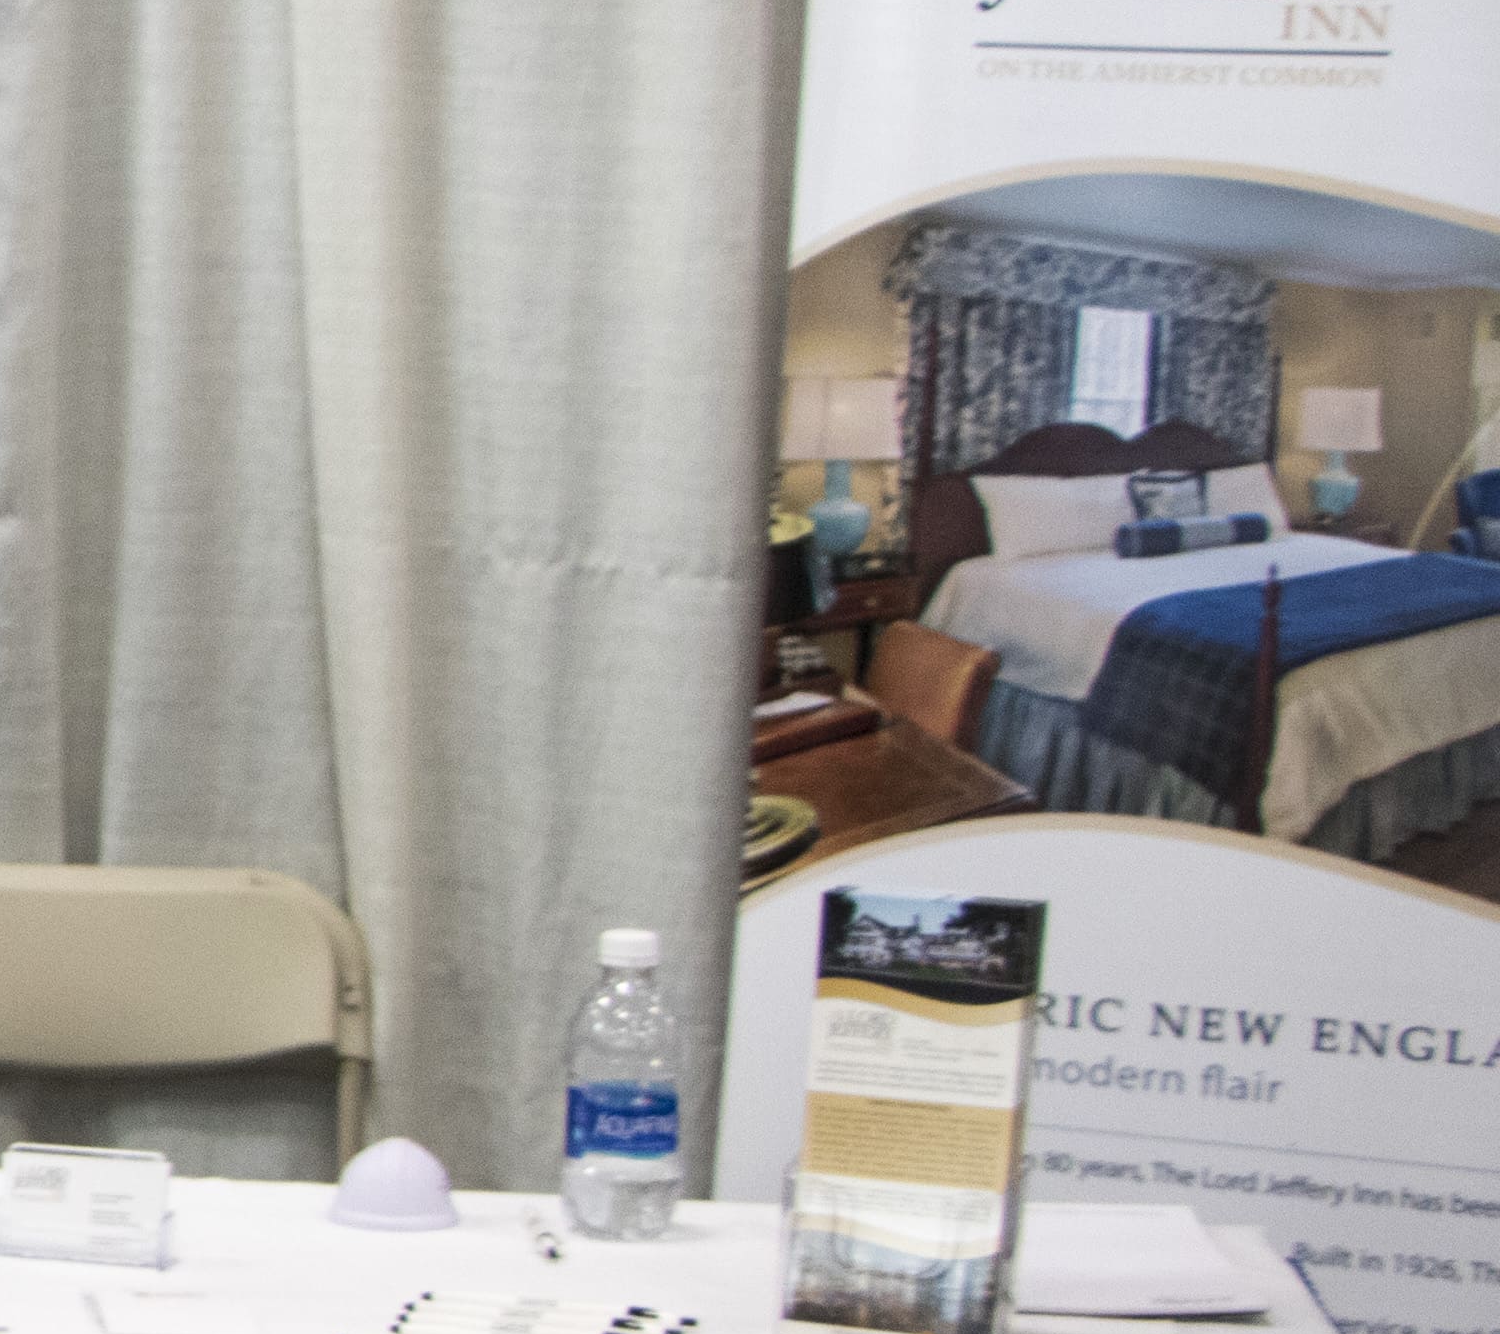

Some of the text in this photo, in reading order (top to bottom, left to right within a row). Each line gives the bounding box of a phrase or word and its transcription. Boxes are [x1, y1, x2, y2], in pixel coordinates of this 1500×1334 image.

[1279, 3, 1392, 43] INN
[1150, 1002, 1284, 1047] NEW
[1201, 1064, 1284, 1104] flair
[1152, 1161, 1196, 1186] The
[1203, 1167, 1259, 1194] Lord
[1402, 1186, 1443, 1211] has
